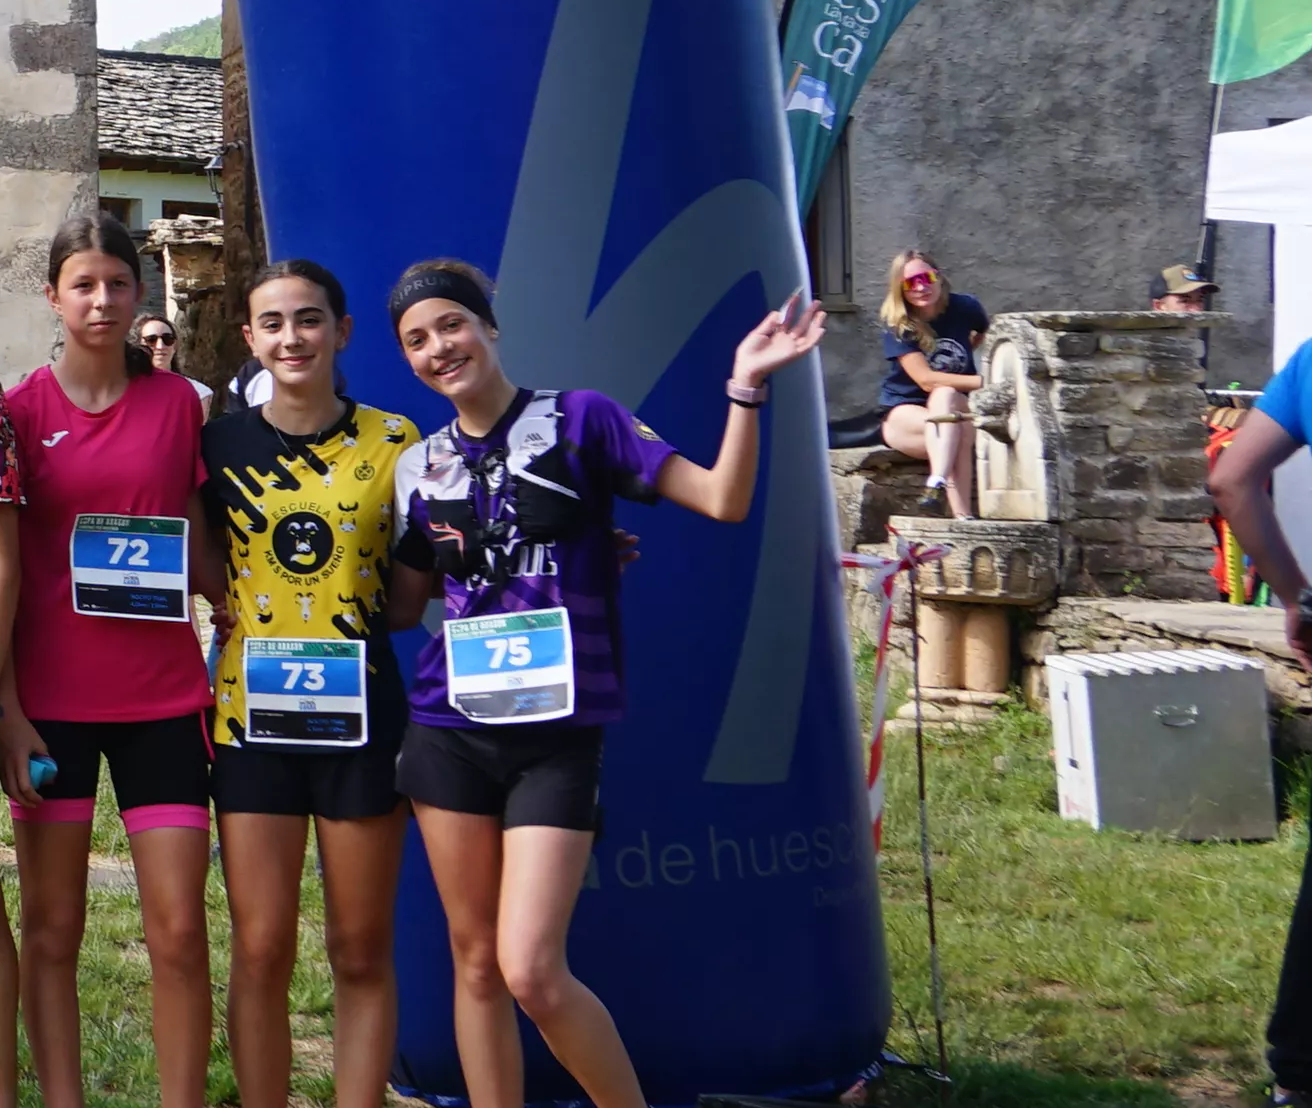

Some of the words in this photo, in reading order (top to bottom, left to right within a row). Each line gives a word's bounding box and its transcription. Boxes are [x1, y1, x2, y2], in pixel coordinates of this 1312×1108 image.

[271, 501, 331, 521] ESCUELA
[108, 537, 150, 567] 72
[280, 572, 303, 587] POR
[304, 576, 320, 587] UN
[484, 636, 533, 669] 75
[280, 661, 326, 691] 73
[614, 828, 698, 890] de
[709, 822, 855, 882] huesc
